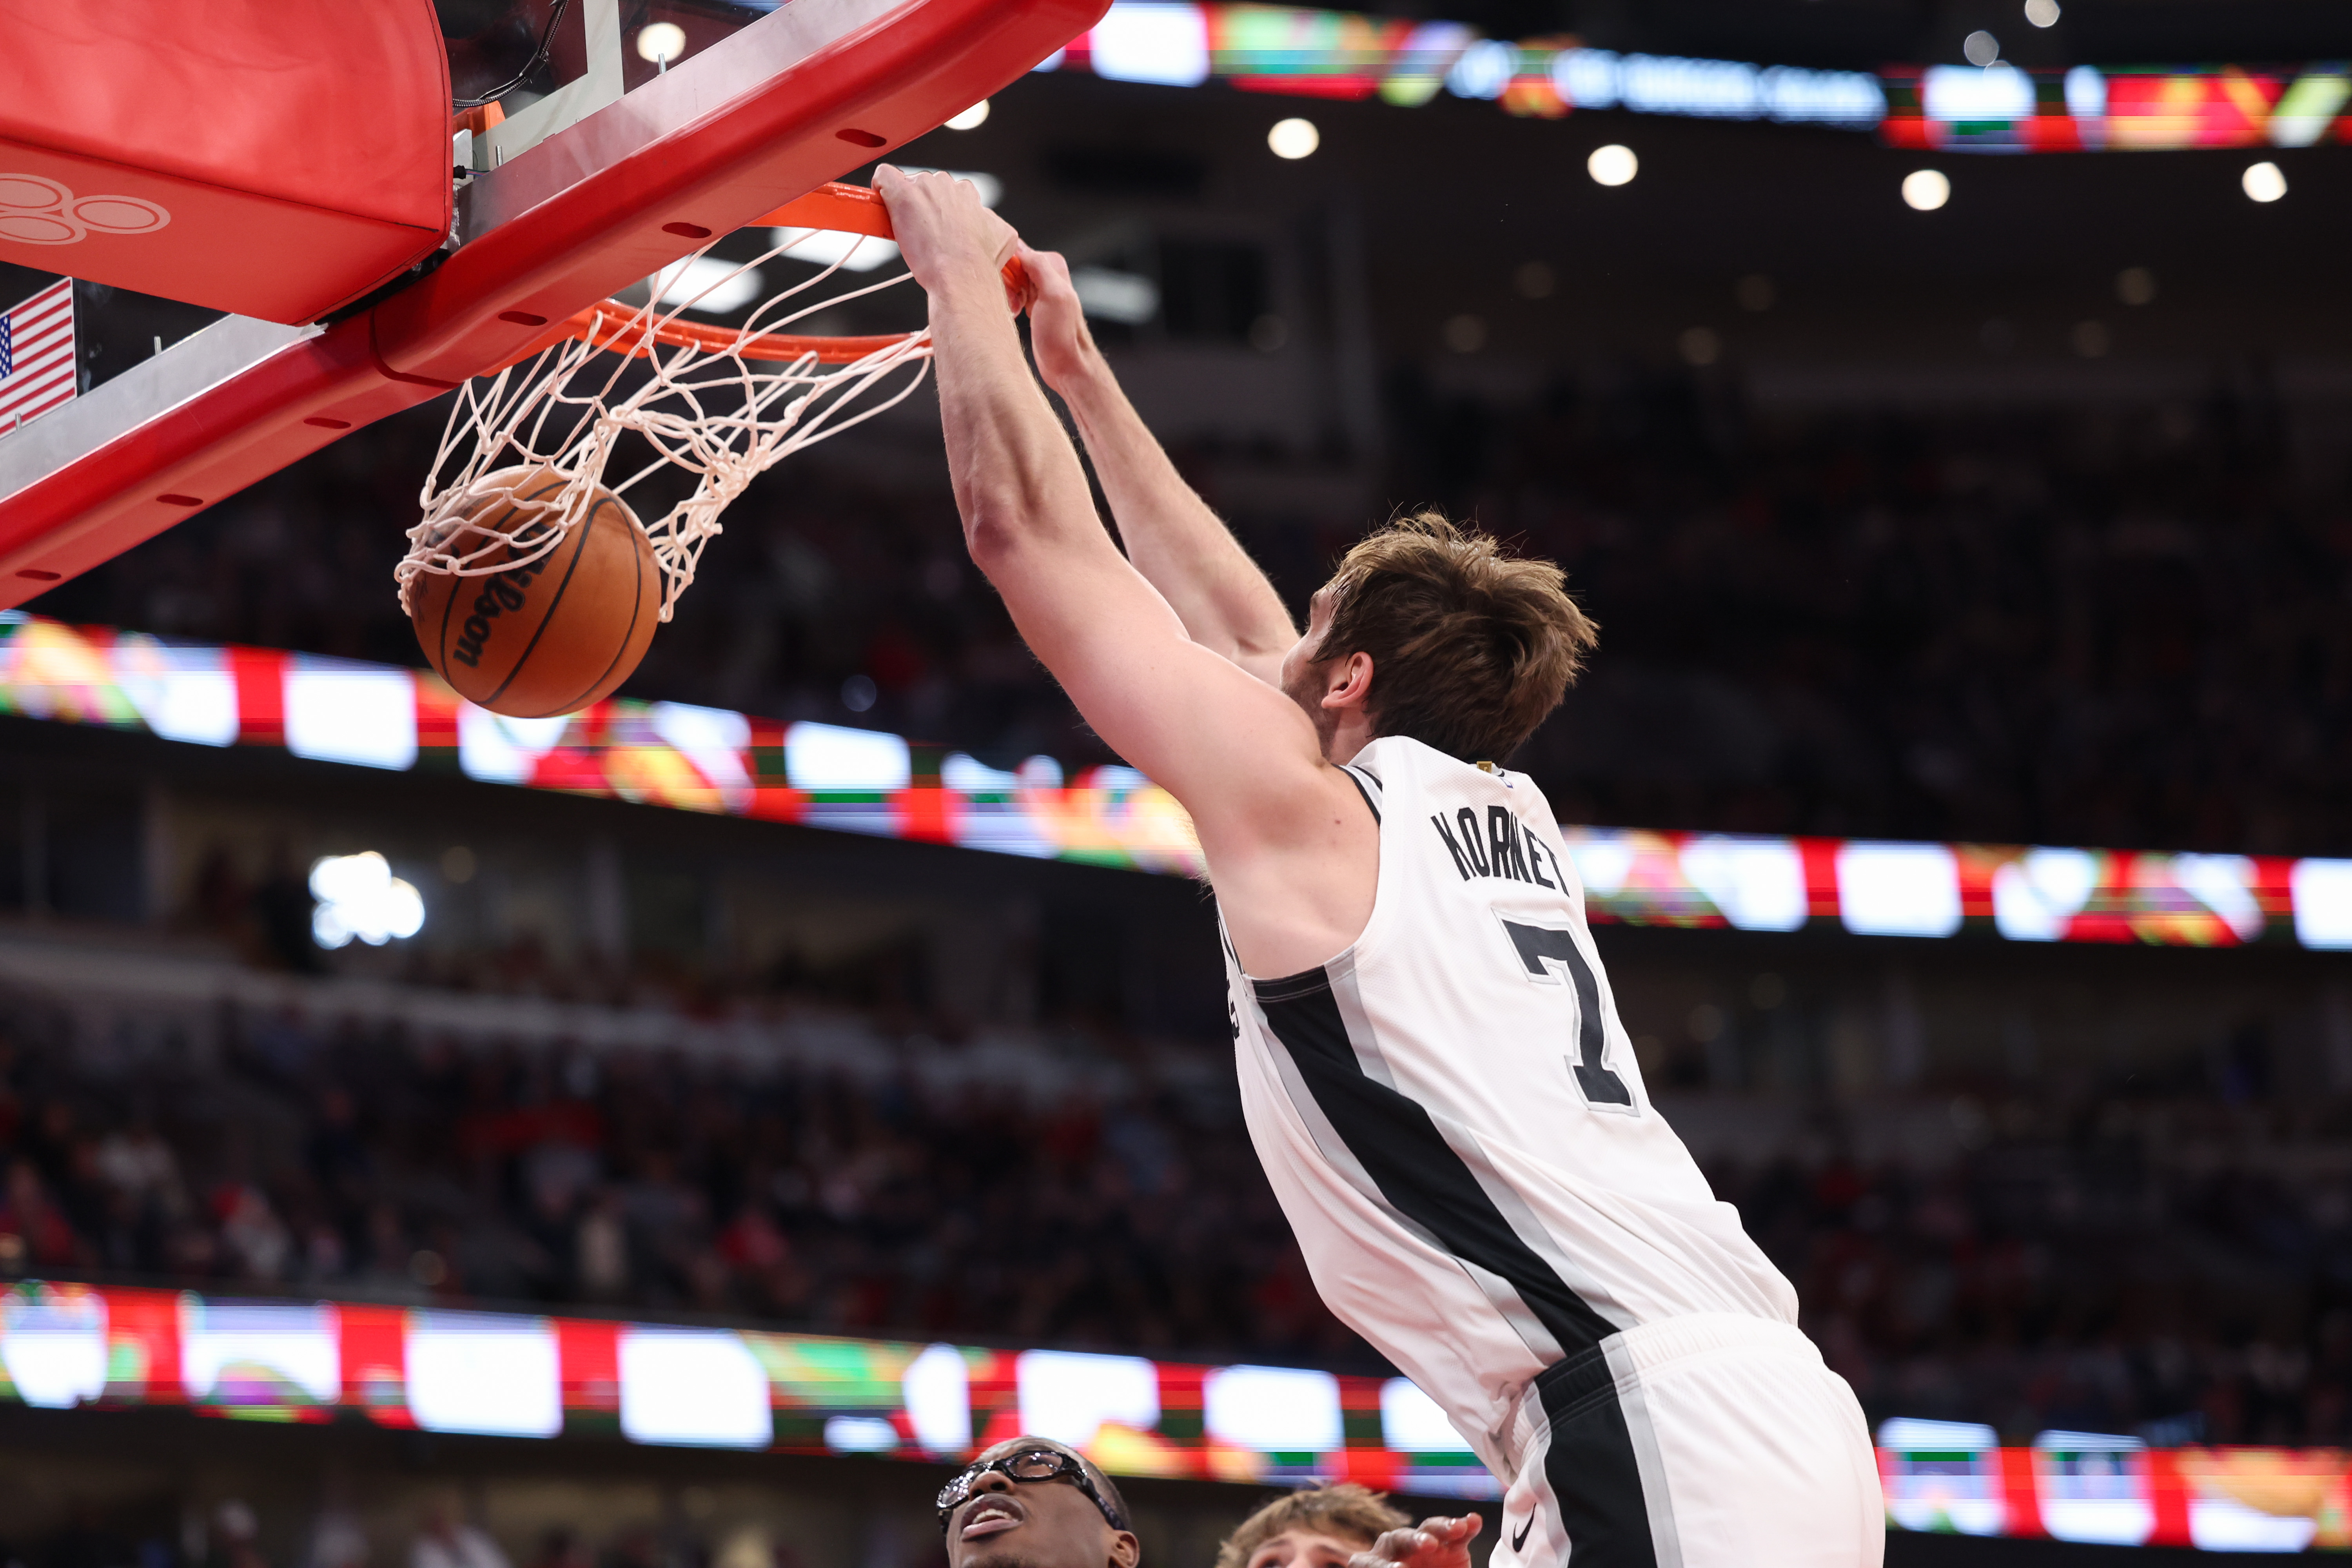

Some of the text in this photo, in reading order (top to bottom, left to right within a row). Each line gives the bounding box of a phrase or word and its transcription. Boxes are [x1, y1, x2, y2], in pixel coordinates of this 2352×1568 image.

[453, 522, 567, 668] Wilson
[1431, 805, 1570, 897] KORNET
[1492, 909, 1639, 1116] 7
